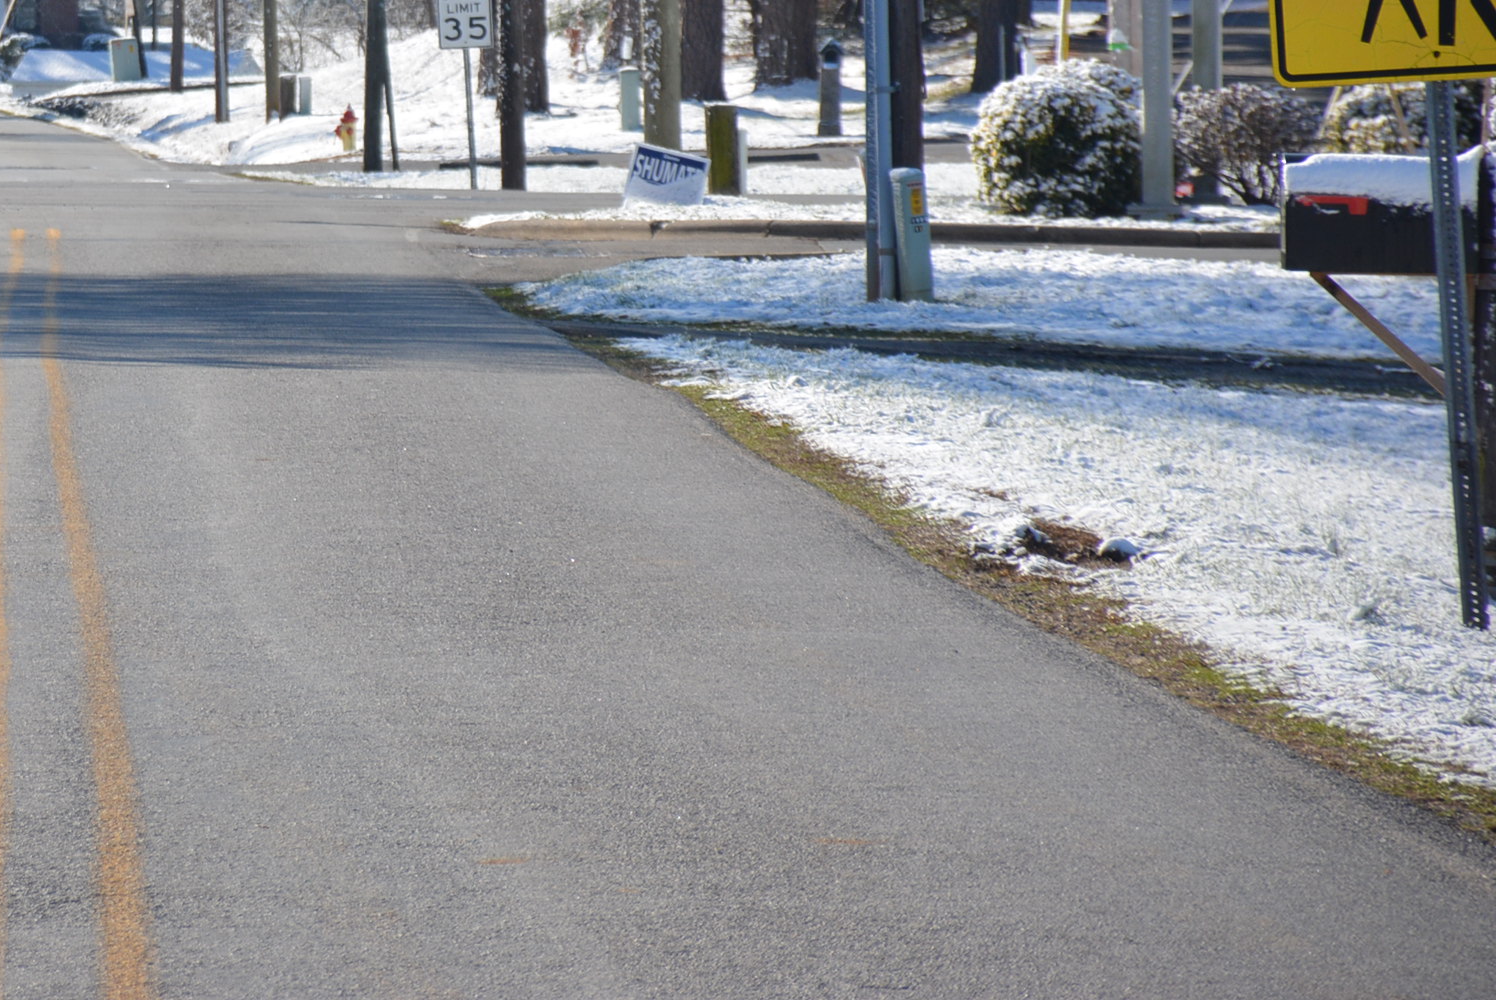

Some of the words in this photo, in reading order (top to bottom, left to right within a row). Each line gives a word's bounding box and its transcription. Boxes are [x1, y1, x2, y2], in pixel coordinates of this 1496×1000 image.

[447, 2, 481, 14] LIMIT
[444, 16, 487, 41] 35
[634, 153, 704, 185] SHUMAT
